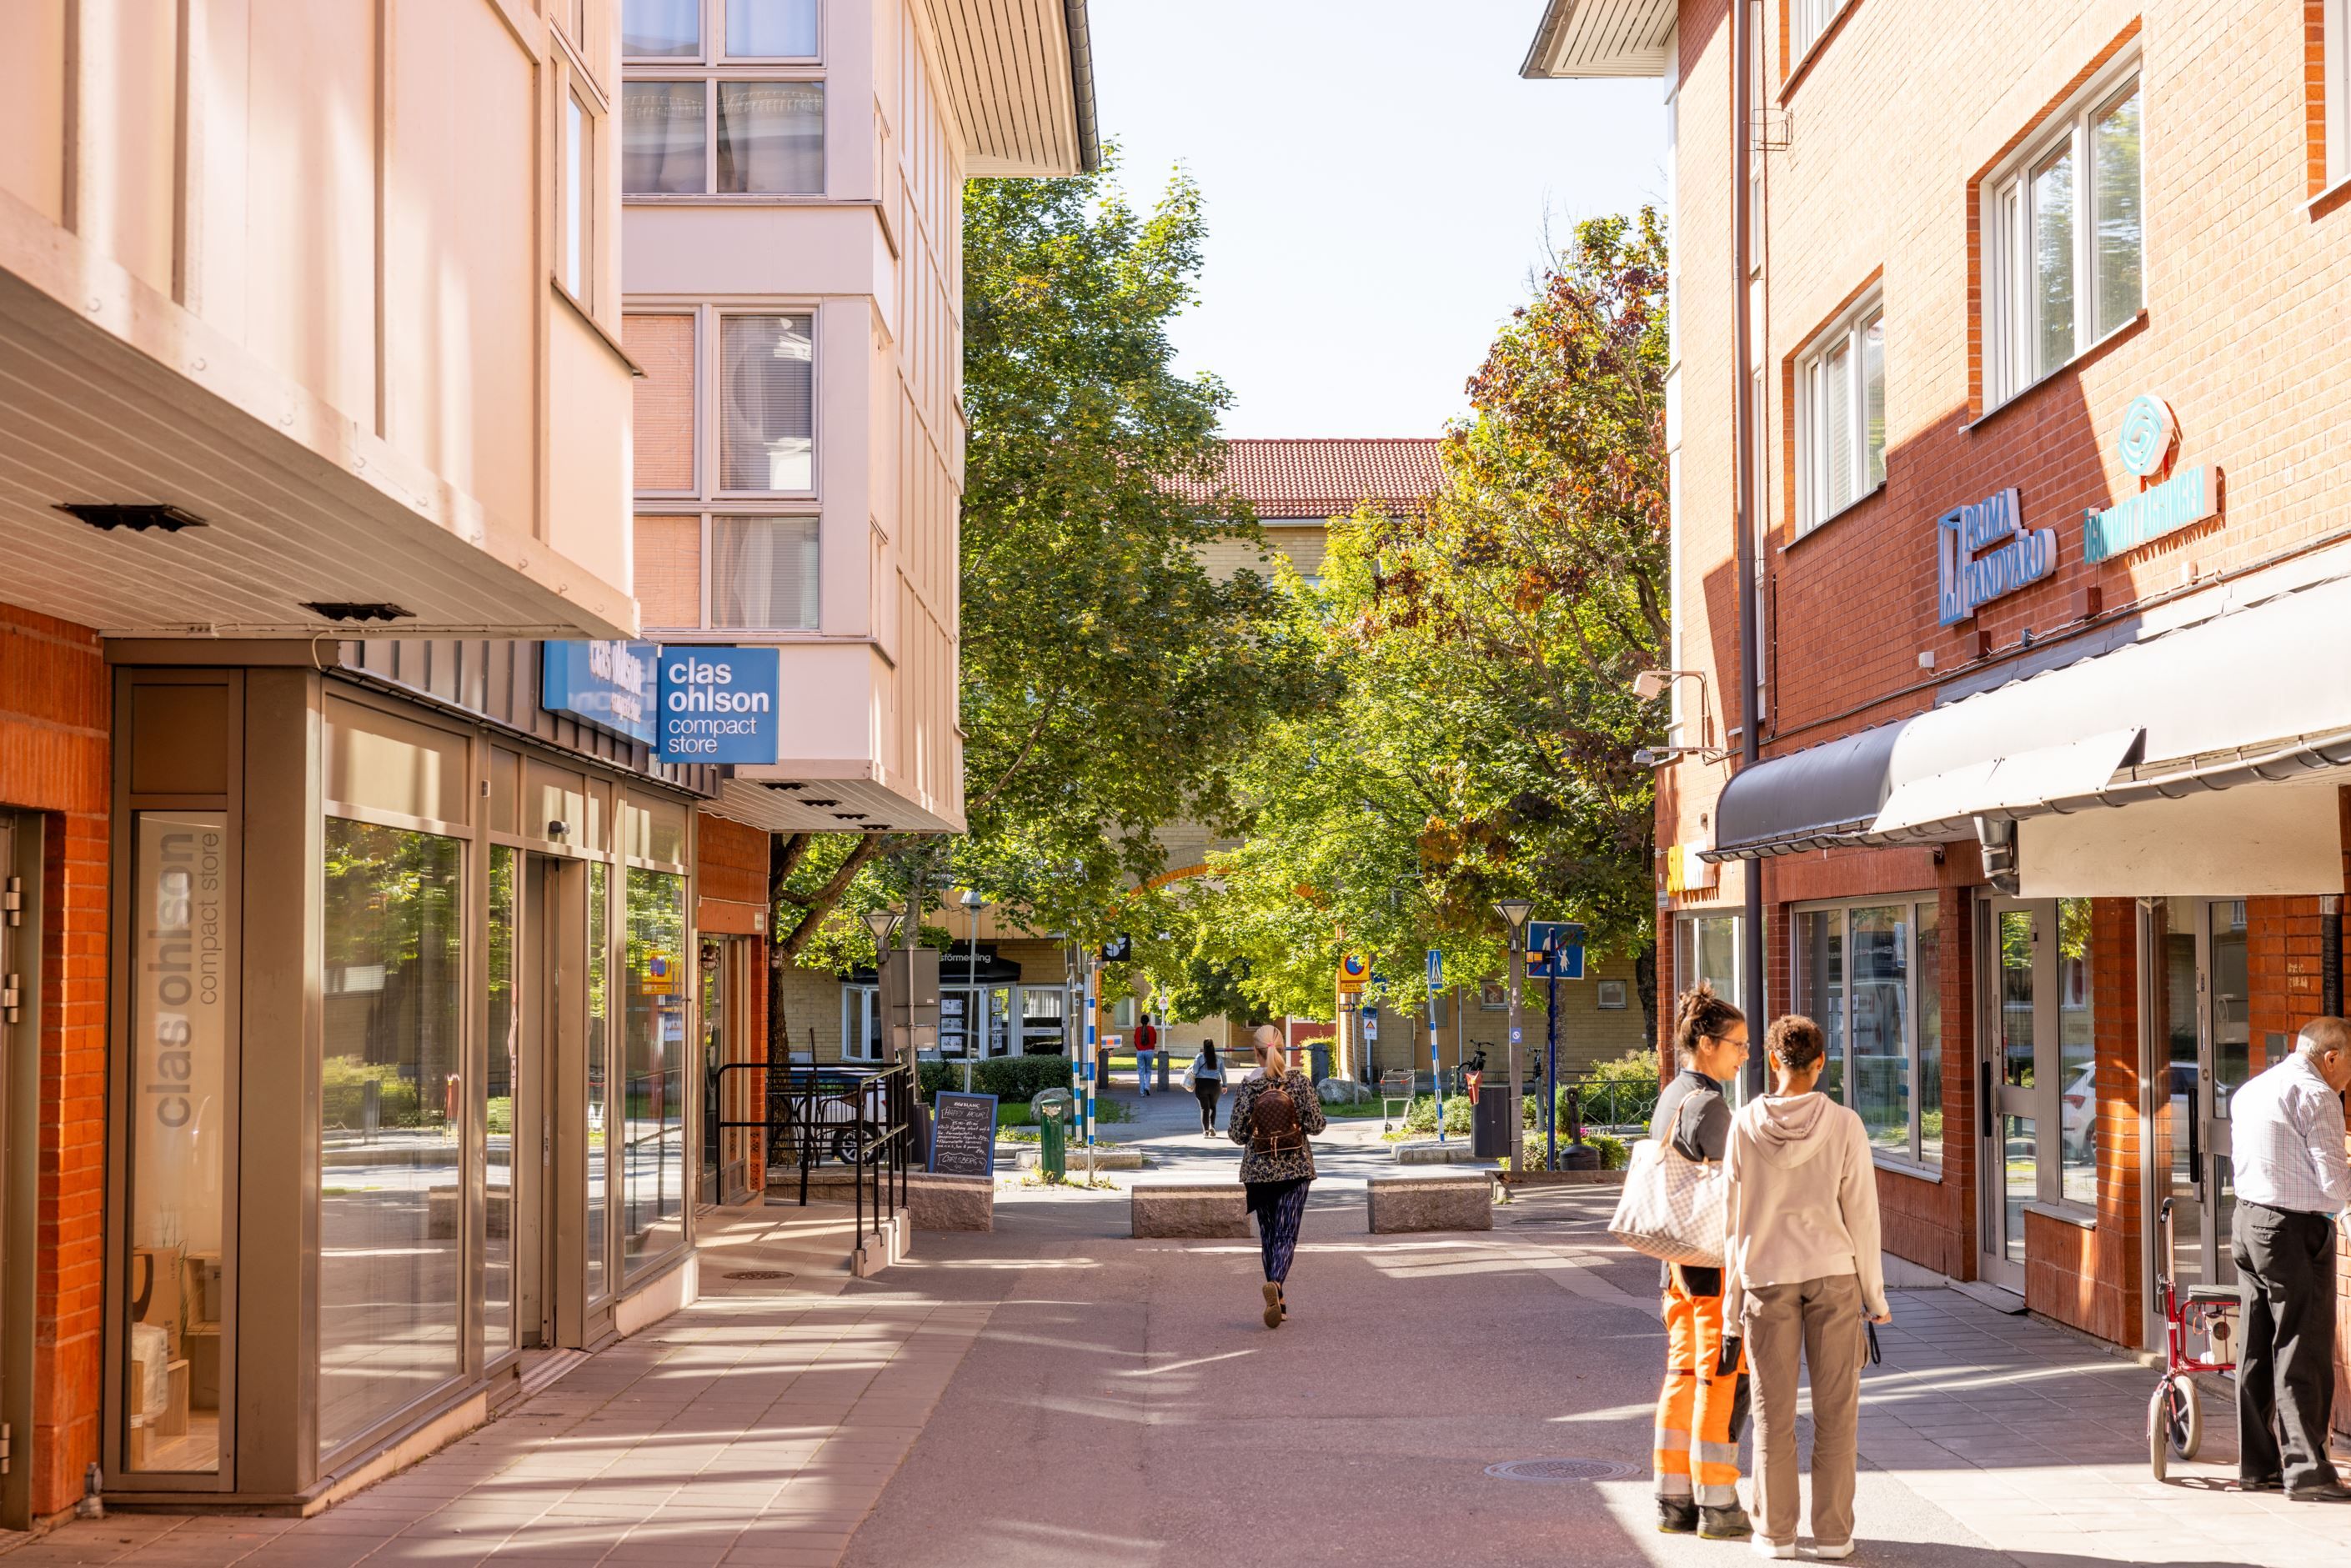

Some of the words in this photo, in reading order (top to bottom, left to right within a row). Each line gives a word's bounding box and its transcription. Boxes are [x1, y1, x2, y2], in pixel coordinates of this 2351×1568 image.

[1964, 488, 2014, 553] PRIMA
[1964, 528, 2049, 608] TANDVÅRD
[668, 657, 732, 684] clas
[668, 684, 769, 713] ohlson
[668, 734, 717, 754] store
[669, 716, 757, 738] compact
[198, 833, 219, 891] store
[147, 832, 194, 1006] ohlson
[197, 900, 223, 1005] compact
[146, 1019, 192, 1128] clas
[944, 1107, 965, 1117] HAPPY
[966, 1110, 986, 1118] HOUR
